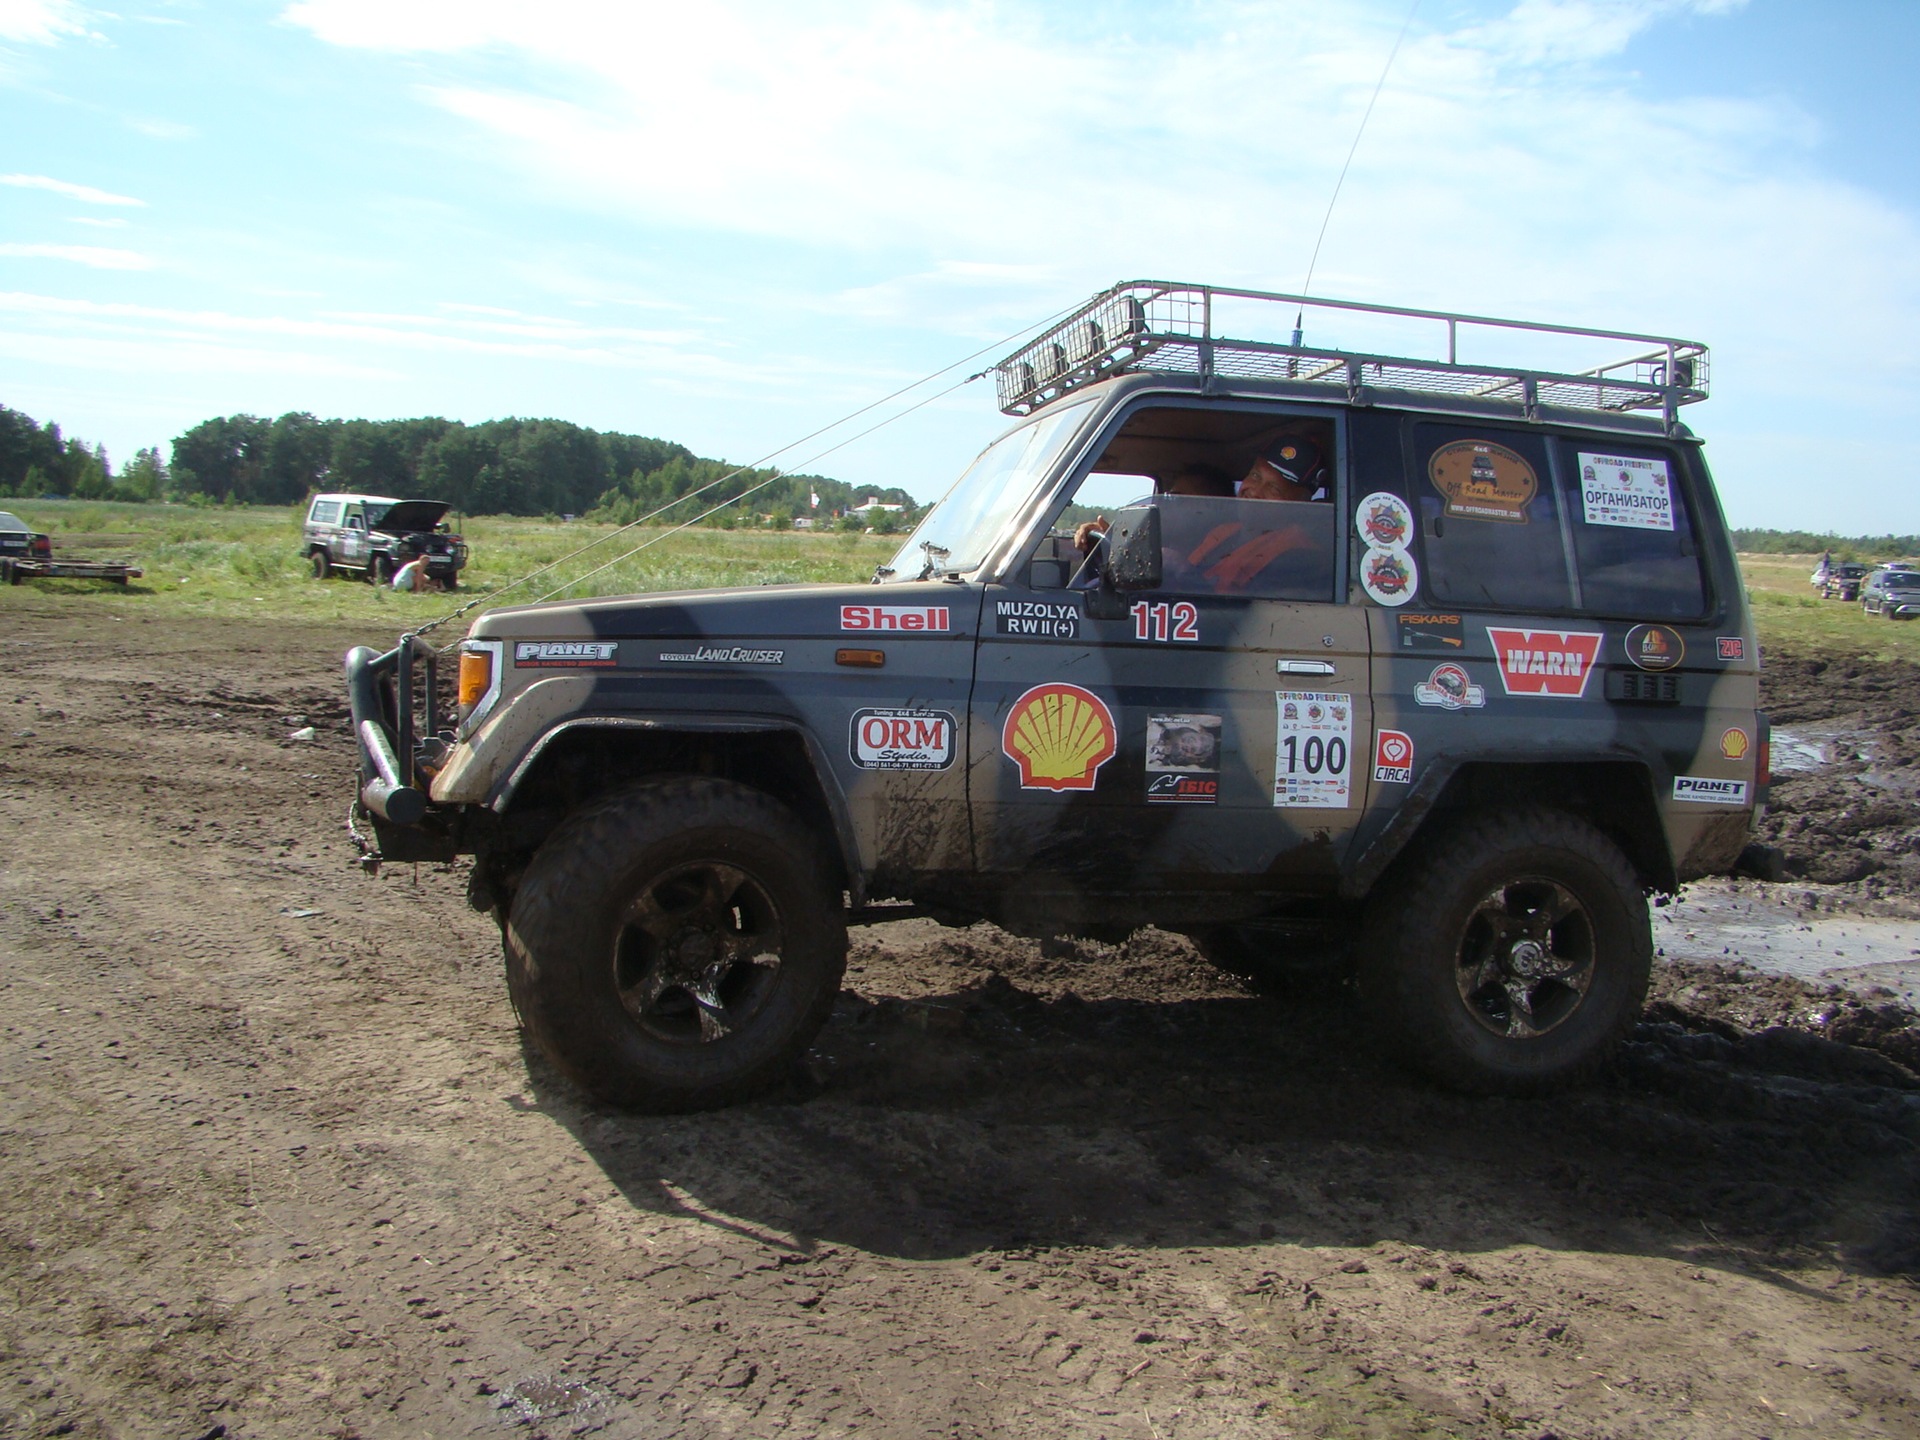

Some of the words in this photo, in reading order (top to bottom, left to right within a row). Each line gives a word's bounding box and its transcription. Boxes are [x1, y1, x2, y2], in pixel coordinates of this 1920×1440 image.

[1465, 484, 1487, 495] Road
[1585, 490, 1669, 510] ОРГАНИЗАТОР
[842, 607, 949, 631] Shell
[996, 601, 1079, 620] MUZOLYA
[1400, 614, 1460, 625] FISKARS
[1130, 600, 1199, 642] 112
[516, 642, 618, 660] PLANET
[661, 653, 695, 661] TOYOTA
[1719, 639, 1742, 657] ZIC
[1507, 649, 1583, 677] WARN
[1278, 692, 1315, 701] OFFROAD
[862, 717, 945, 750] ORM
[1283, 735, 1347, 775] 100
[1676, 779, 1745, 795] PLANET
